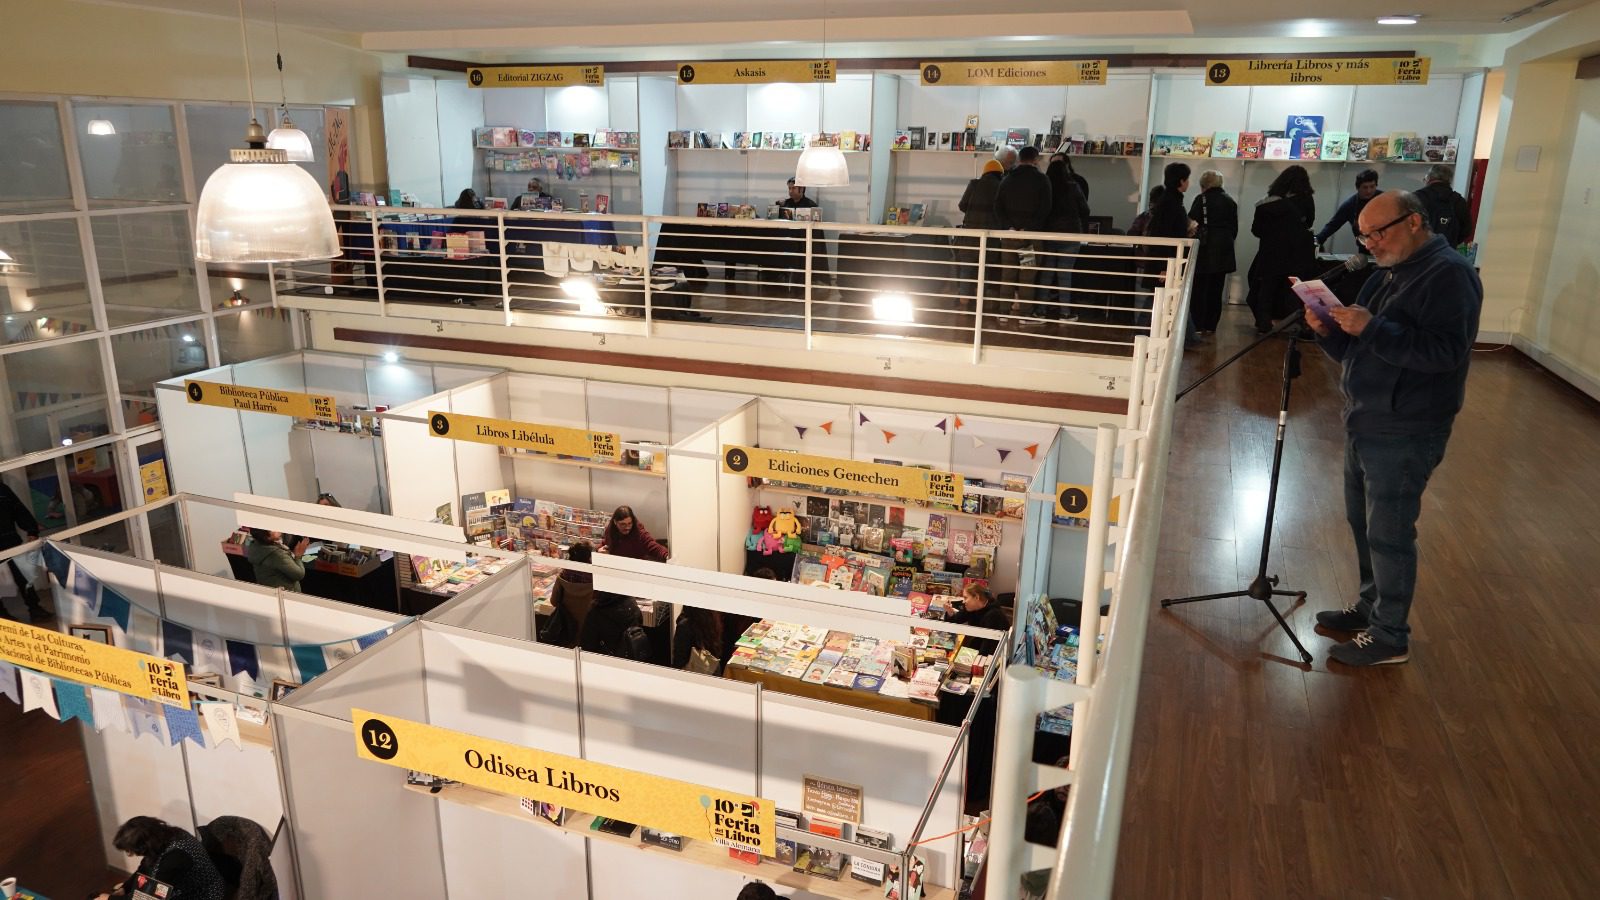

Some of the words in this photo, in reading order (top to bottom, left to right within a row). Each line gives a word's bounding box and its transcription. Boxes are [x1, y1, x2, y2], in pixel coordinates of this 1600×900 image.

[1248, 60, 1293, 71] Librería
[1296, 59, 1332, 70] Libros
[1335, 61, 1343, 72] y
[1346, 58, 1369, 69] más
[472, 73, 482, 82] 16
[498, 73, 529, 82] Editorial
[531, 73, 564, 82] ZIGZAG
[682, 69, 692, 78] 15
[734, 68, 766, 77] Askasis
[927, 69, 938, 79] 14
[967, 68, 994, 78] LOM
[997, 67, 1047, 78] Ediciones
[1213, 68, 1227, 78] 13
[1290, 72, 1323, 83] libros
[192, 387, 199, 397] 4
[219, 385, 258, 399] Biblioteca
[259, 390, 289, 403] Pública
[233, 398, 251, 410] Paul
[253, 401, 277, 412] Harris
[436, 420, 444, 429] 3
[476, 424, 510, 440] Libros
[512, 429, 555, 445] Libélula
[594, 441, 614, 451] Feria
[733, 455, 742, 466] 2
[768, 458, 830, 478] Ediciones
[833, 468, 899, 487] Genechen
[930, 481, 954, 492] Feria
[935, 490, 954, 499] Libro
[1070, 495, 1077, 507] 1
[19, 627, 30, 637] de
[31, 630, 46, 642] Las
[47, 633, 87, 653] Culturas,
[4, 635, 25, 649] Artes
[27, 641, 32, 650] y
[33, 642, 42, 653] el
[43, 644, 91, 665] Patrimonio
[36, 655, 46, 666] de
[47, 657, 94, 678] Bibliotecas
[95, 669, 132, 689] Públicas
[149, 674, 180, 691] Feria
[158, 688, 181, 701] Libro
[368, 729, 393, 750] 12
[464, 749, 540, 784] Odisea
[545, 766, 620, 803] Libros
[714, 812, 761, 835] Feria
[725, 829, 761, 847] Libro
[714, 837, 730, 847] Villa
[731, 842, 761, 854] Alemana
